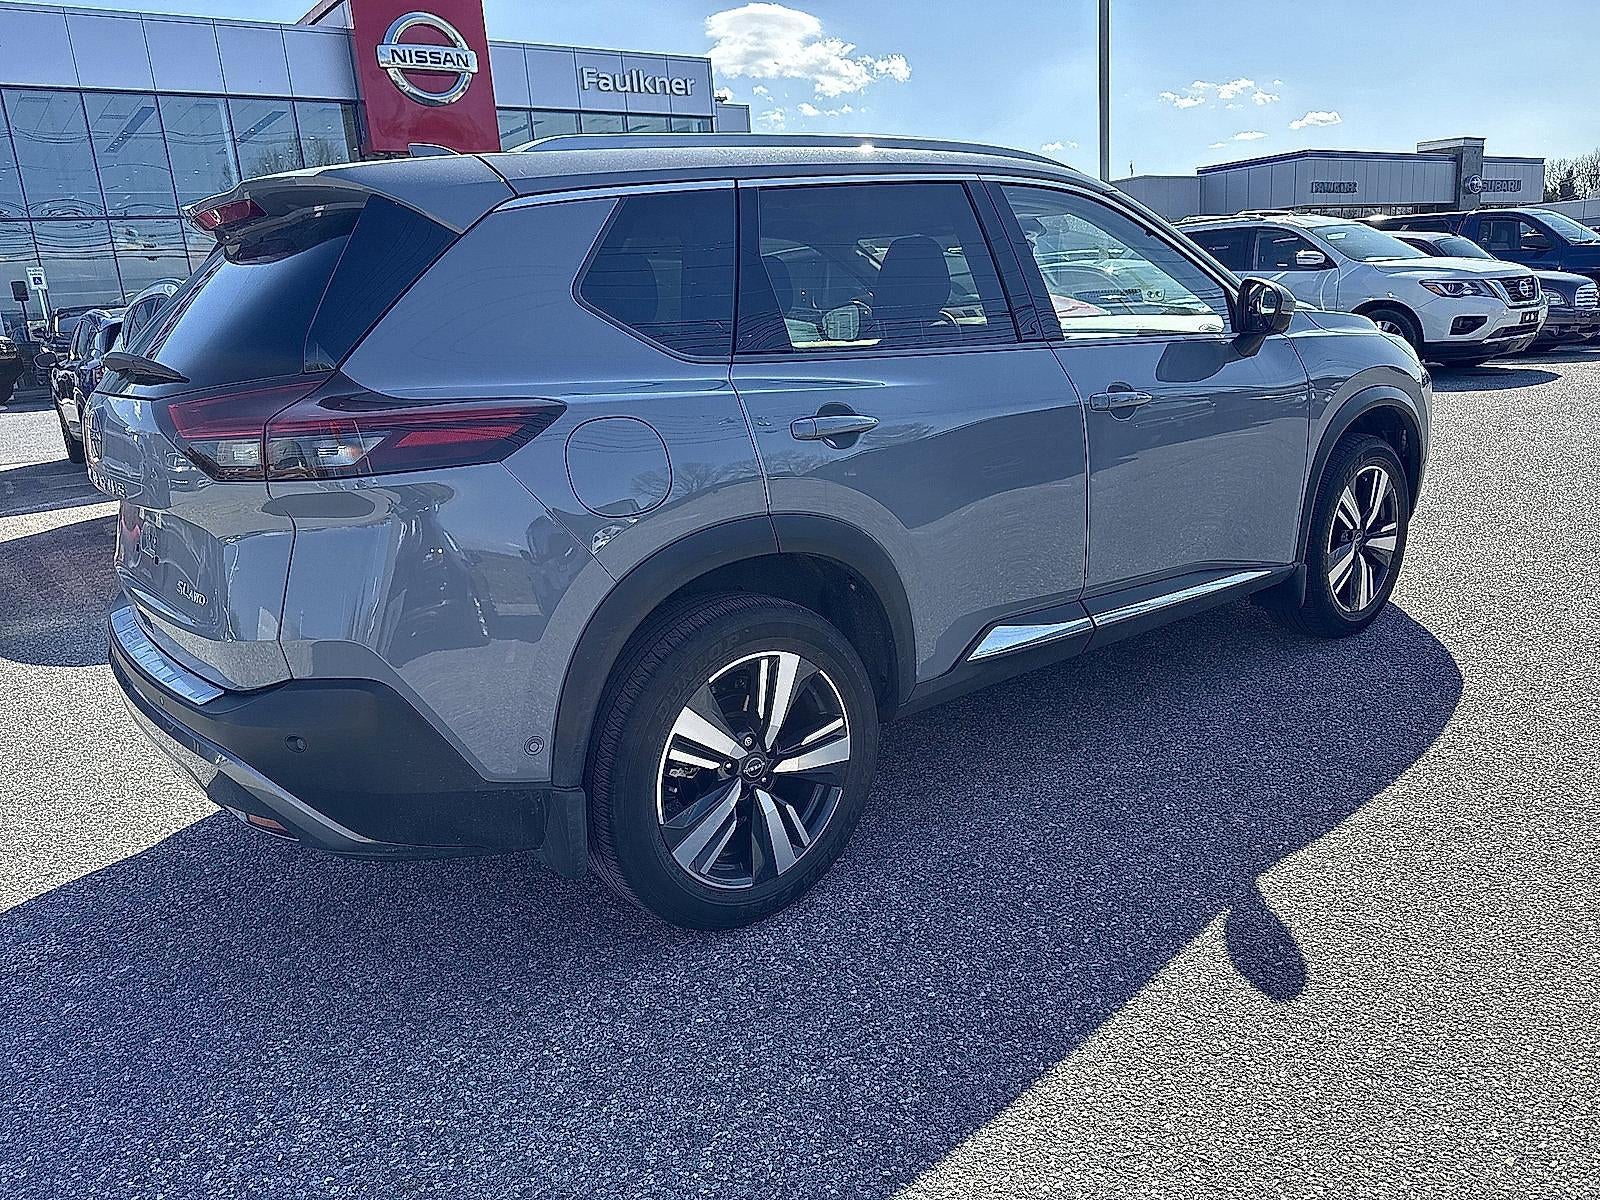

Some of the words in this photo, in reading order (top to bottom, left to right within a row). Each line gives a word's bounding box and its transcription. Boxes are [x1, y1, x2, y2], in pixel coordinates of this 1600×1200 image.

[389, 48, 469, 68] NISSAN
[581, 66, 696, 96] Faulkner
[1482, 179, 1521, 192] SUBARU
